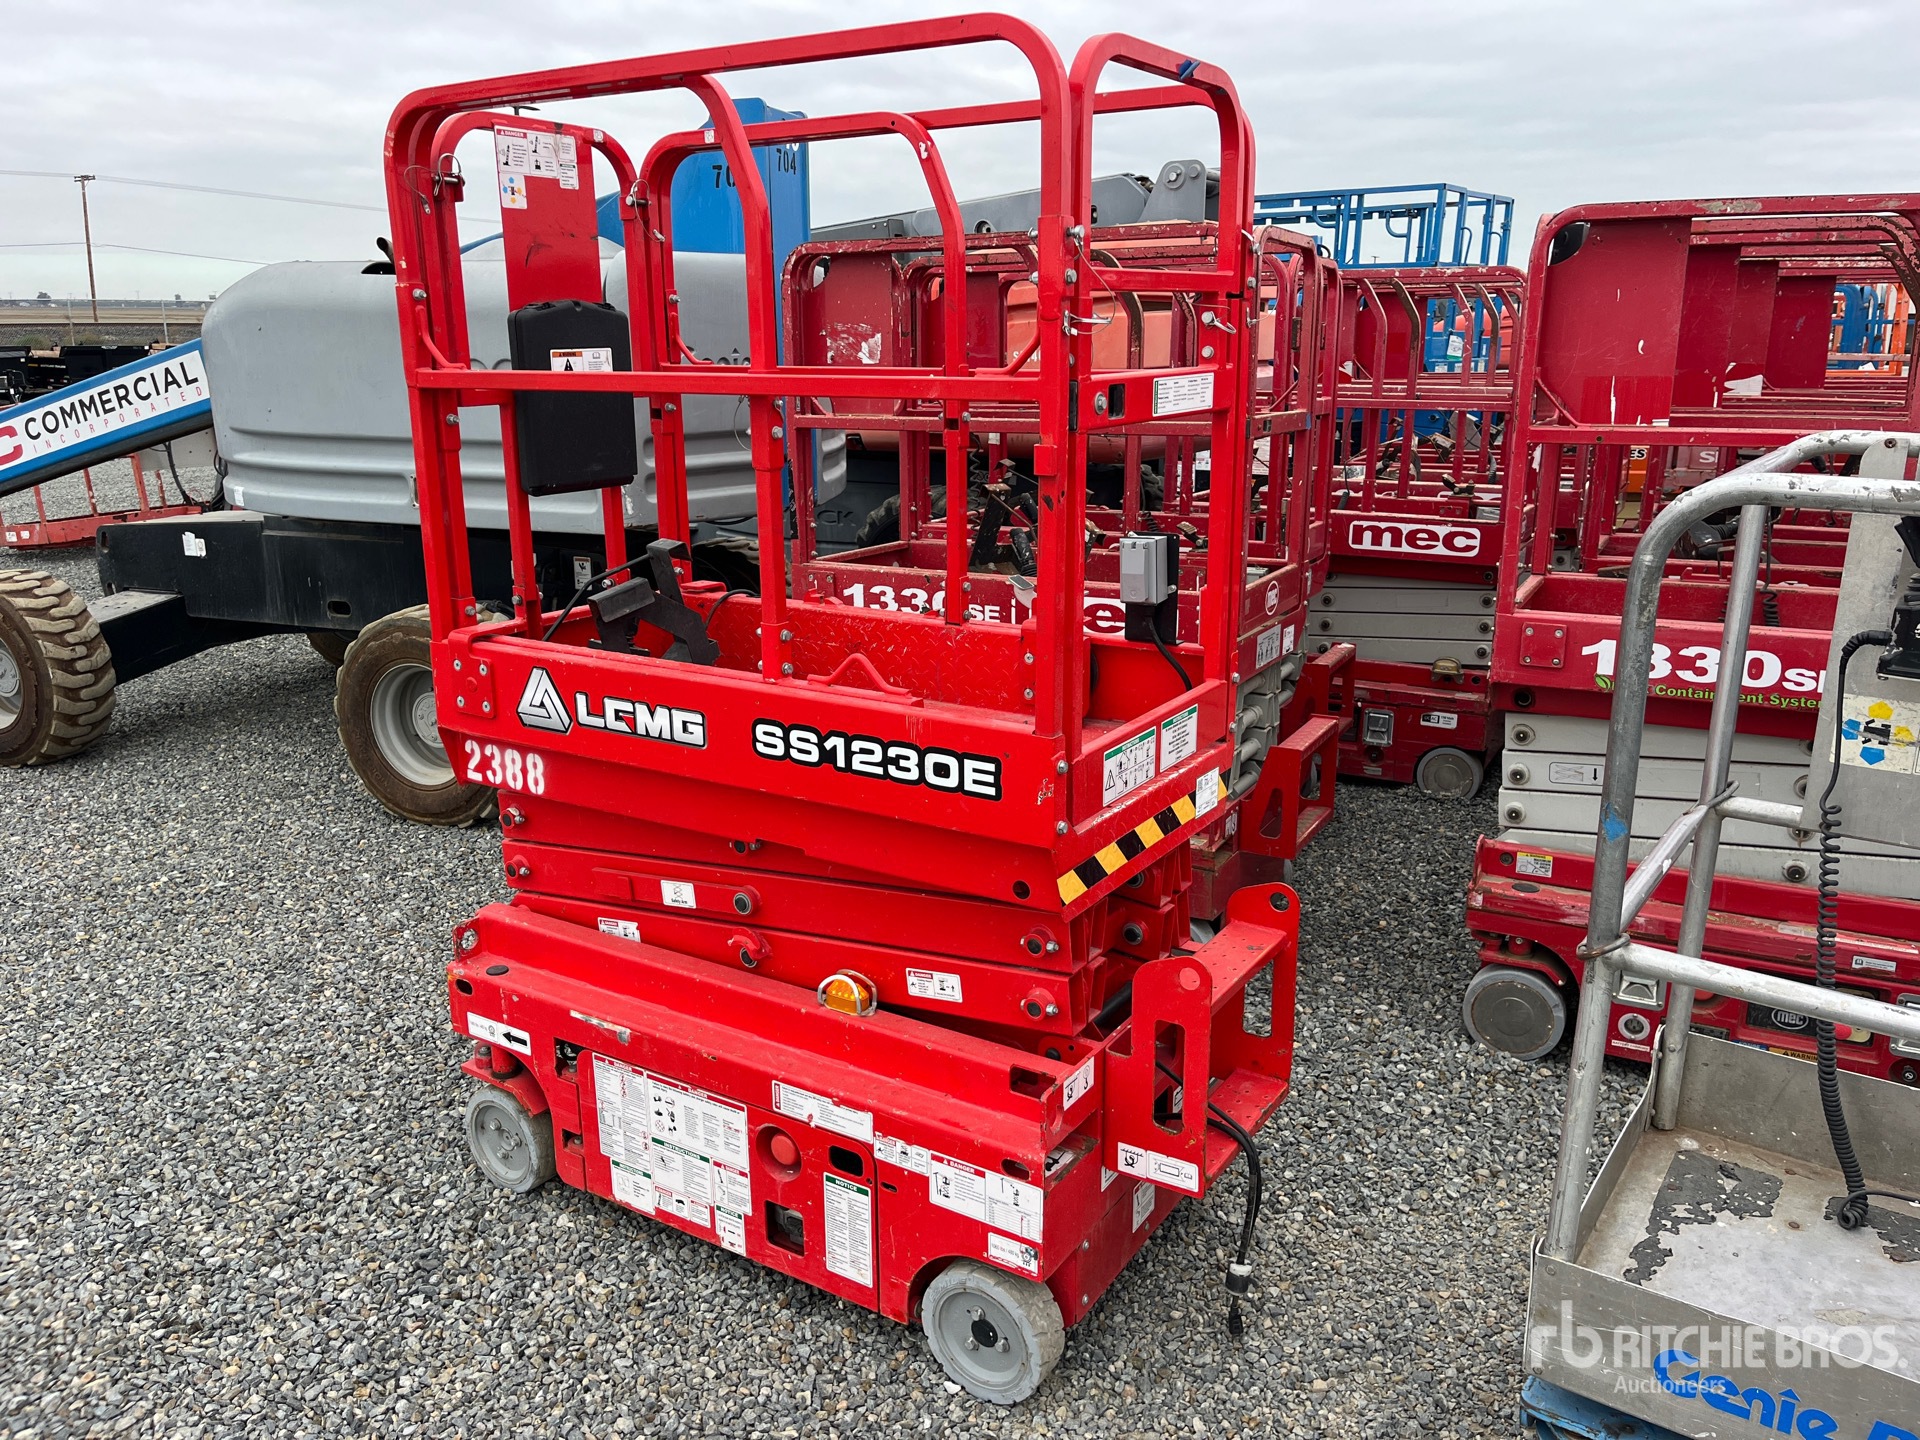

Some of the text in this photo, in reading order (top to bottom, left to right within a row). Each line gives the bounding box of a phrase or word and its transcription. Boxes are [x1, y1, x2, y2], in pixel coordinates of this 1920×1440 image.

[776, 148, 797, 175] 704
[24, 362, 199, 441] COMMERCIAL
[33, 386, 202, 454] INCORPORATED
[1351, 524, 1478, 553] mec
[1655, 685, 1763, 704] Containent
[1769, 694, 1823, 709] Syste
[464, 739, 545, 795] 2388
[755, 722, 996, 796] SS1230E
[1776, 1009, 1804, 1024] mec
[1790, 1051, 1818, 1061] WARNIN
[663, 1142, 700, 1160] INSTRUCTIONS
[949, 1161, 975, 1174] DANGER
[835, 1179, 858, 1192] NOTICE
